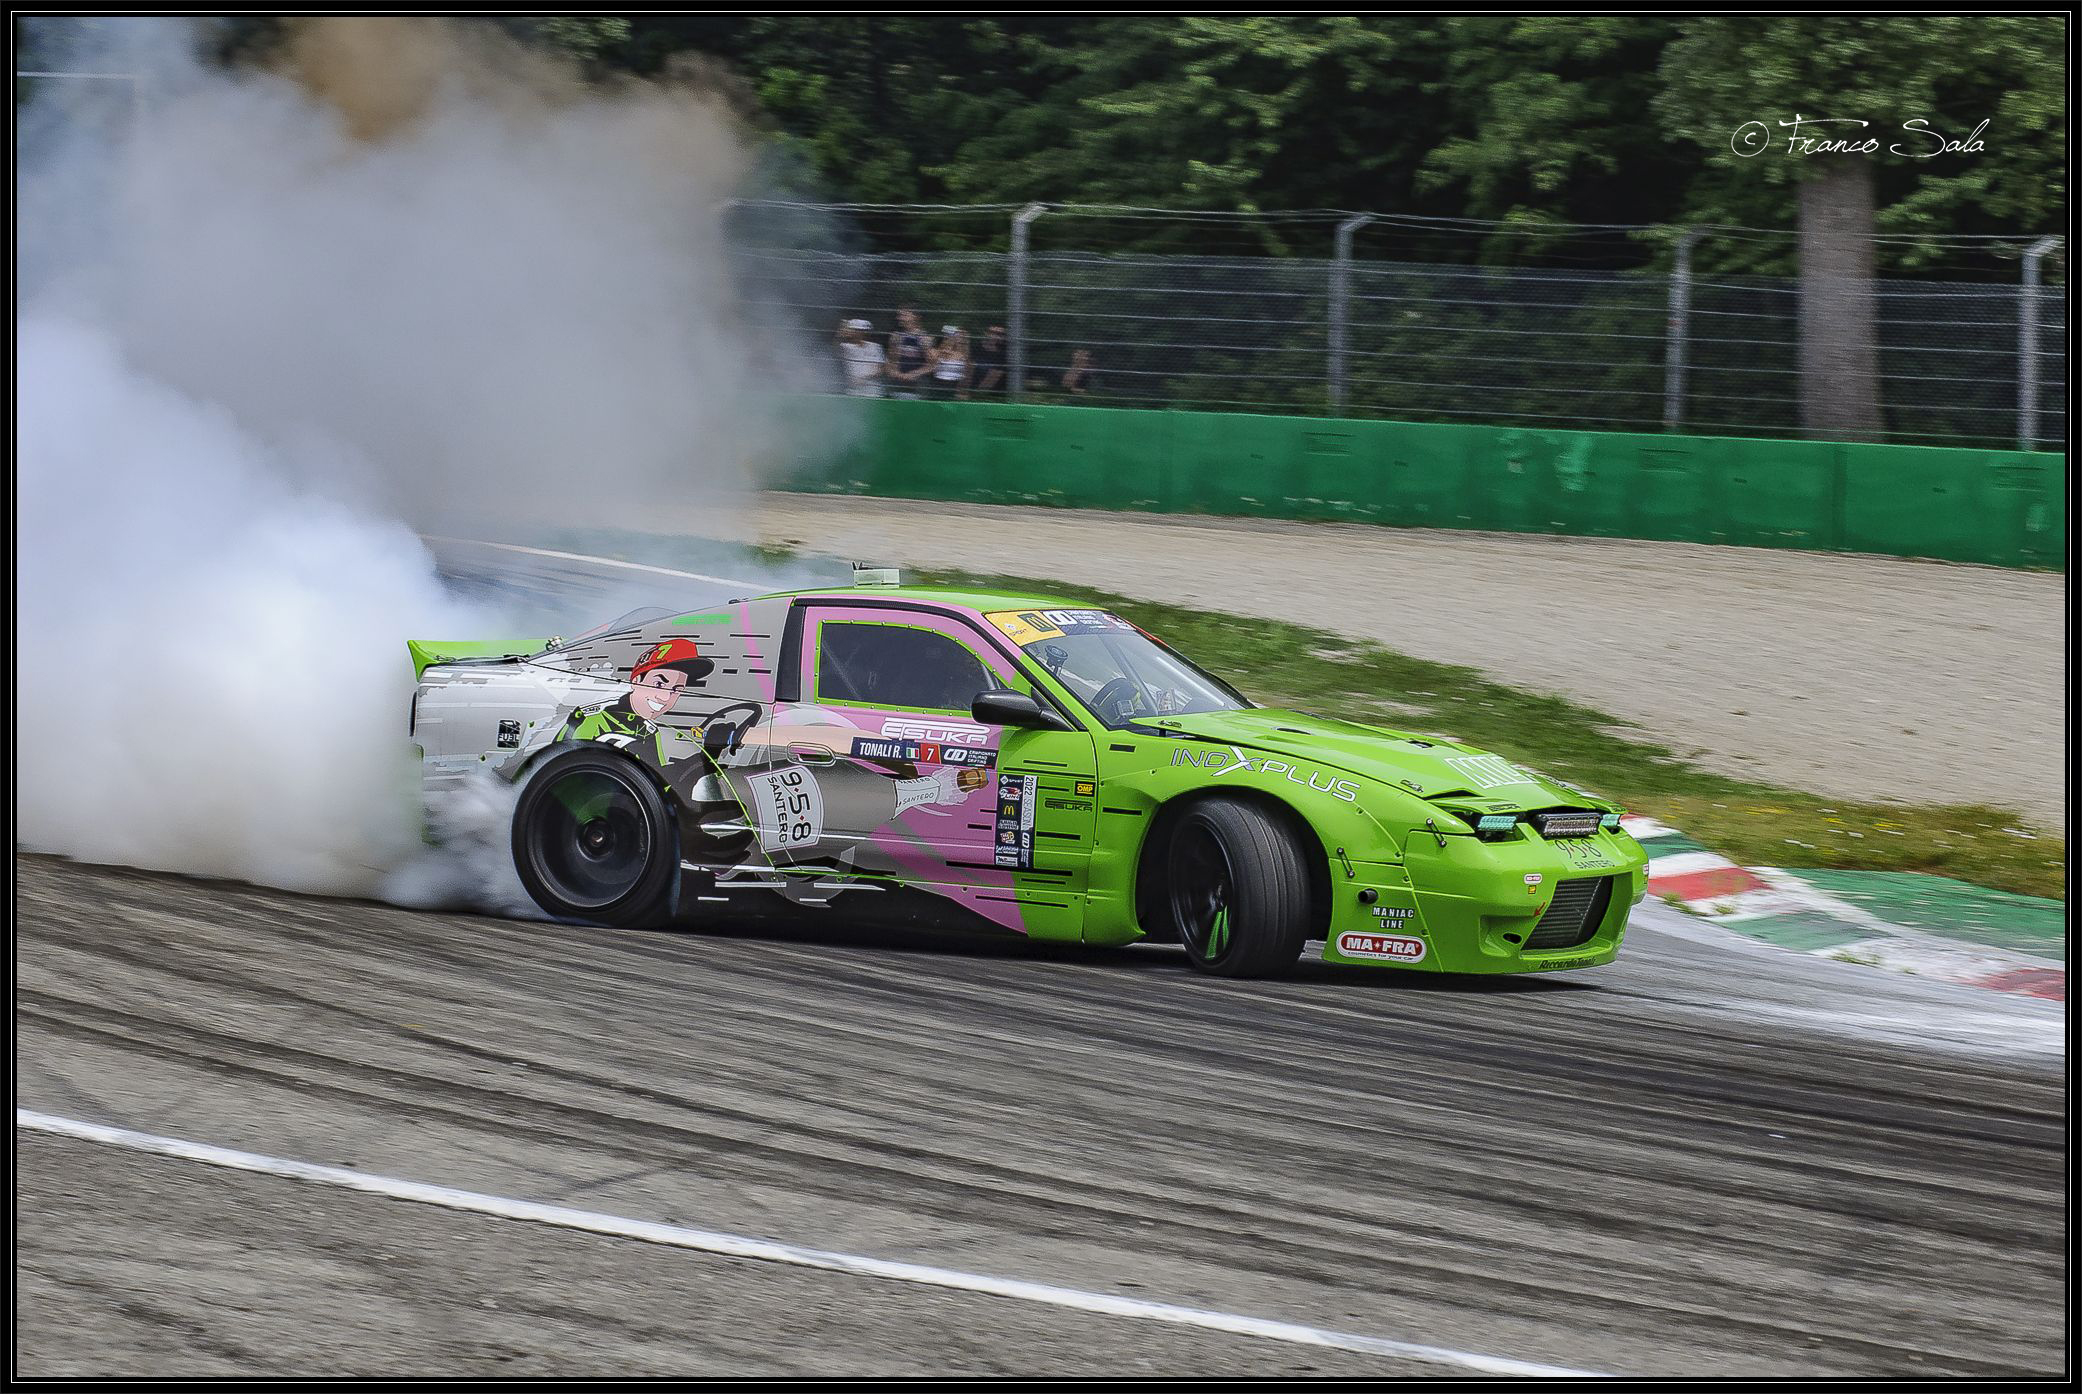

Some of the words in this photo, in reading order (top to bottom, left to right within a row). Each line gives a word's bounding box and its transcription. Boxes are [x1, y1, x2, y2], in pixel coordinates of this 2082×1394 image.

[860, 742, 893, 759] TONALI
[926, 748, 936, 761] 7
[1024, 776, 1034, 796] 2022
[1077, 784, 1093, 793] OMP
[902, 792, 935, 805] SANTERO
[767, 776, 788, 844] SANTERO
[1373, 907, 1414, 919] MANIAC
[1380, 919, 1404, 929] LINE
